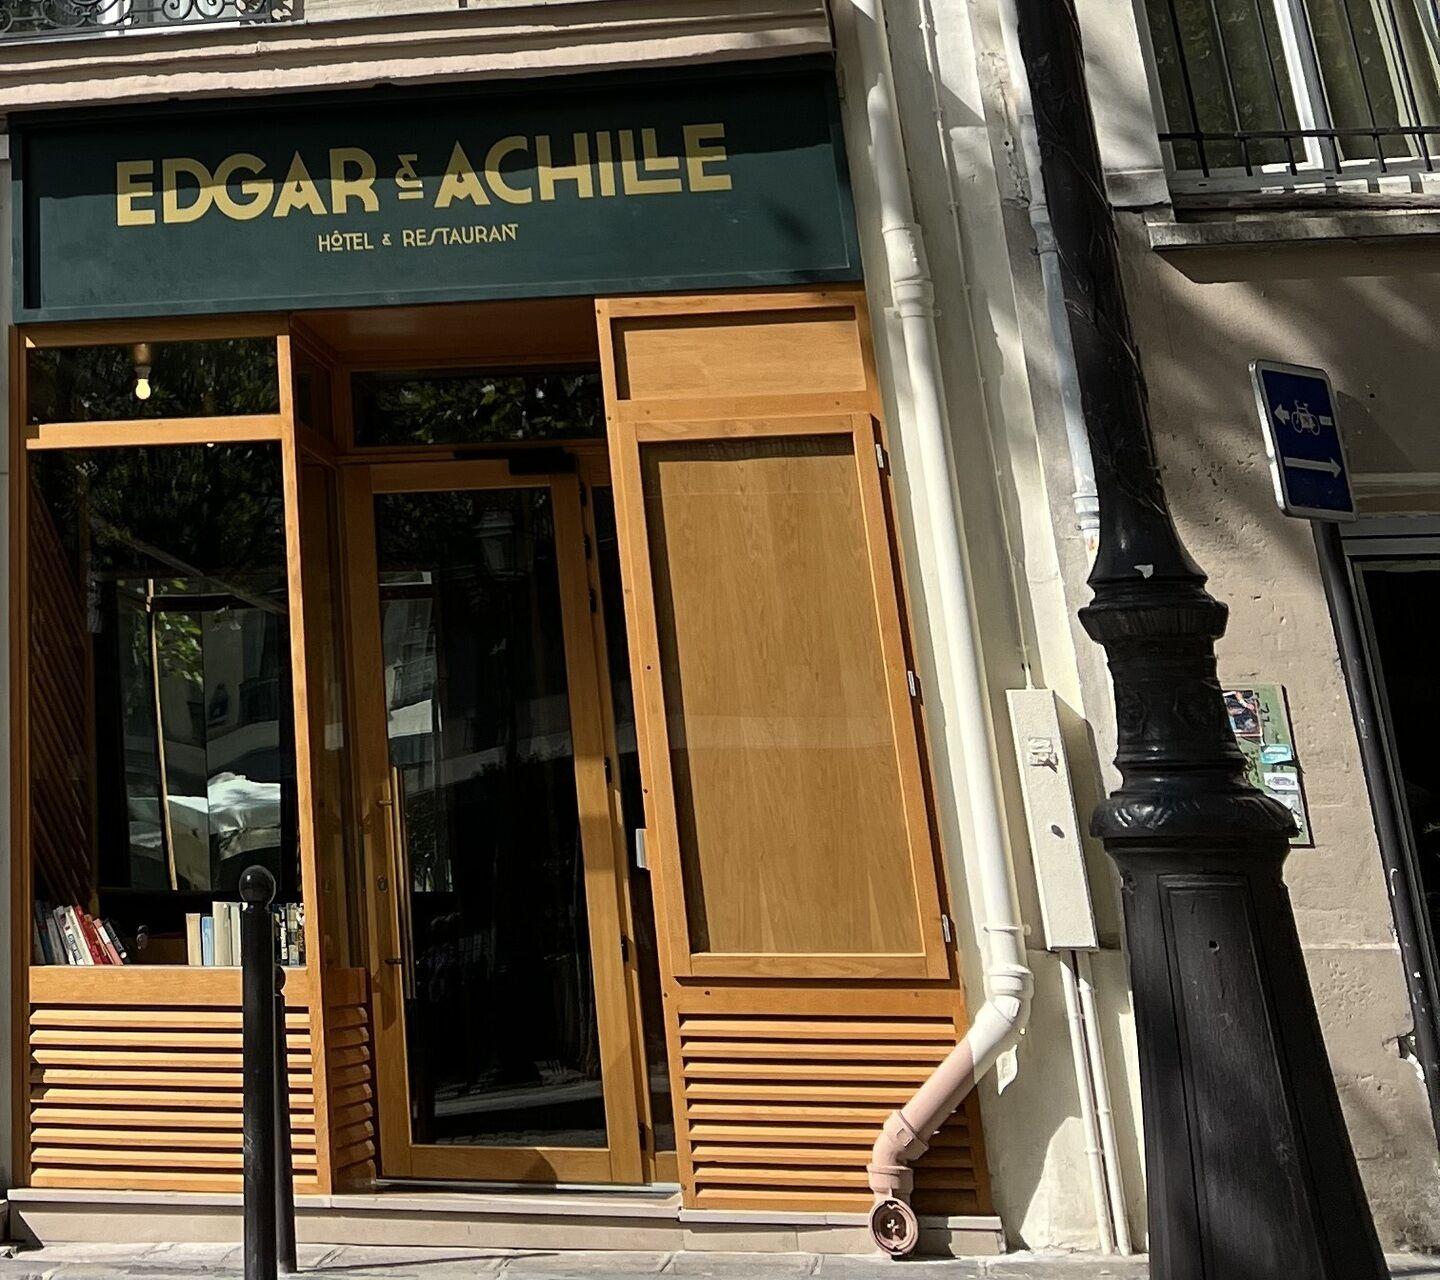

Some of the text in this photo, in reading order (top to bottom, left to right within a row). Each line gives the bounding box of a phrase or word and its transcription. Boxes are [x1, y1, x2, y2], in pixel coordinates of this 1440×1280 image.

[115, 147, 379, 226] EDGAR
[433, 122, 734, 209] ACHILLE
[317, 223, 519, 253] HÔTEL & RESTAURANT
